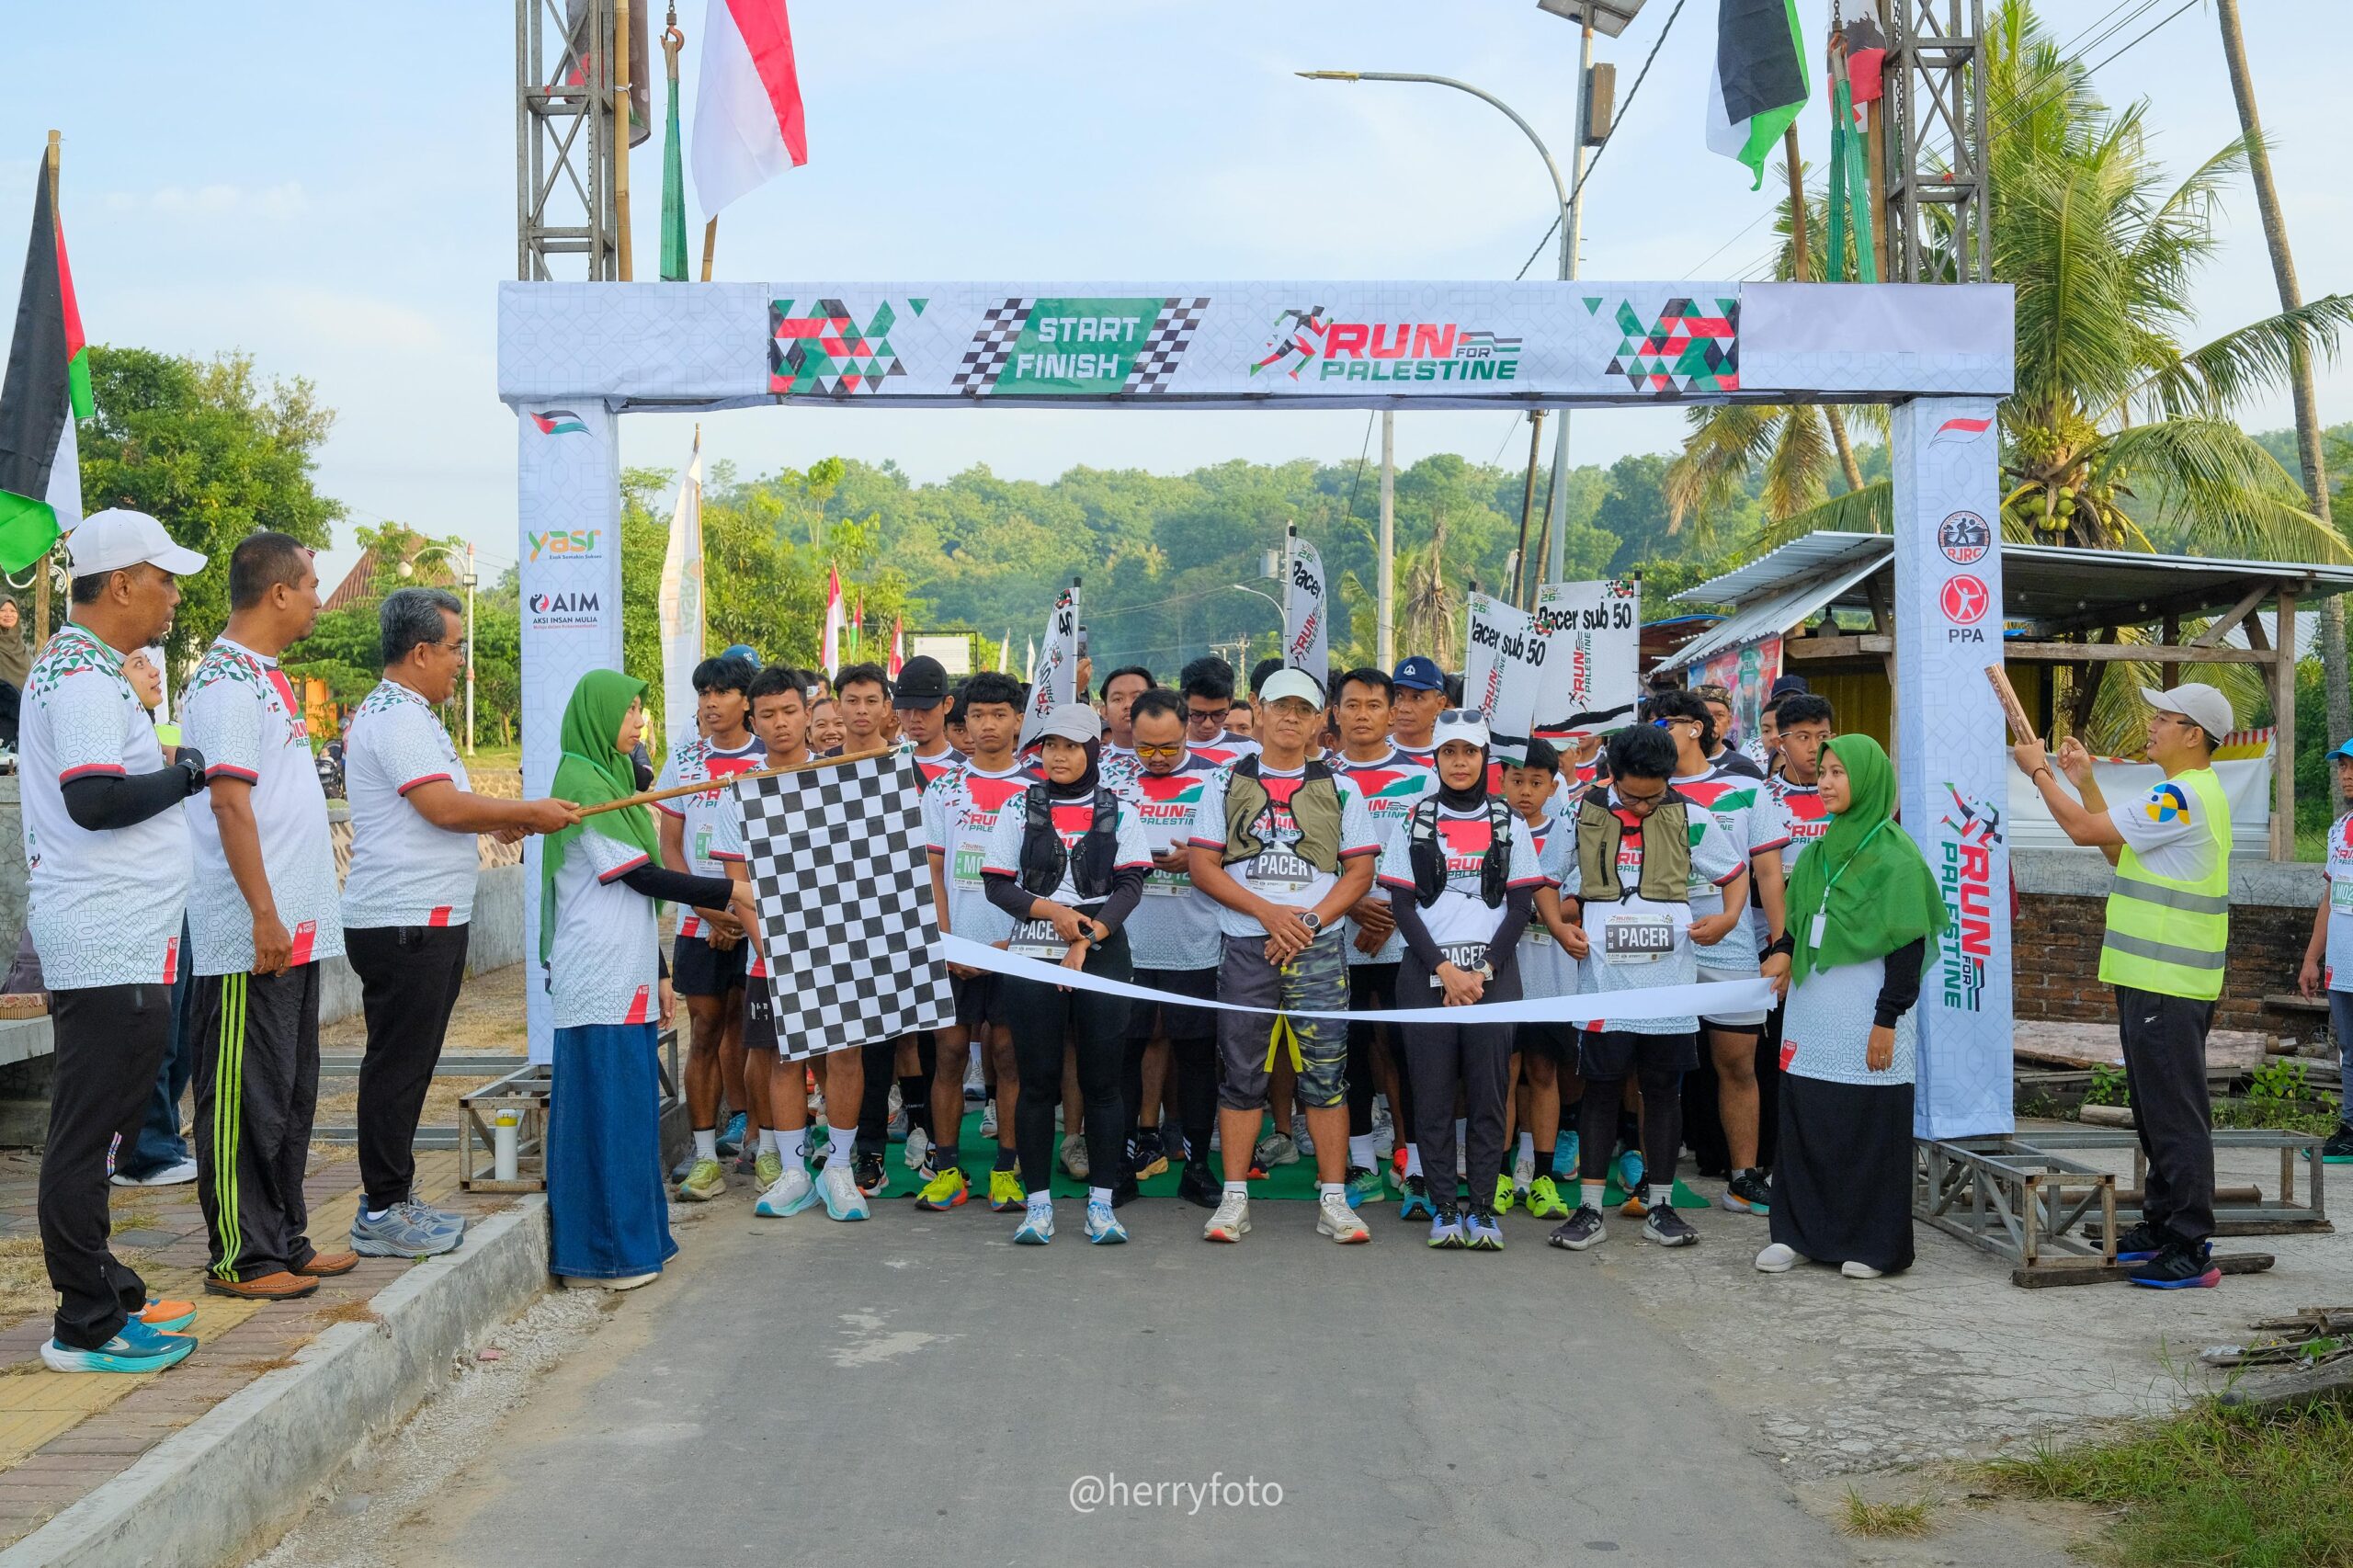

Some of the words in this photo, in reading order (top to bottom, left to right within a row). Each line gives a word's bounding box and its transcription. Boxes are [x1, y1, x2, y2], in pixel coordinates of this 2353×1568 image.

[1038, 317, 1141, 343] START
[1324, 324, 1457, 359] RUN
[1455, 347, 1491, 358] FOR
[1016, 353, 1119, 379] FINISH
[1319, 360, 1518, 381] PALESTINE
[1947, 548, 1982, 562] RJRC
[551, 592, 600, 612] AIM
[1583, 602, 1609, 630] sub
[1613, 603, 1632, 630] 50
[1296, 613, 1316, 650] RUN
[1949, 629, 1984, 643] PPA
[1501, 632, 1524, 660] sub
[1526, 638, 1546, 666] 50
[1584, 631, 1592, 693] PALESTINE
[1492, 655, 1506, 714] PALESTINE
[1573, 651, 1585, 692] RUN
[1484, 668, 1498, 710] RUN
[1140, 804, 1185, 818] RUN
[1140, 817, 1194, 826] PALESTIN
[1257, 855, 1308, 877] PACER
[1617, 852, 1642, 865] RU
[1959, 844, 1991, 957] RUN
[1619, 927, 1669, 948] PACER
[1941, 841, 1961, 1009] PALESTINE
[1961, 956, 1971, 985] FOR
